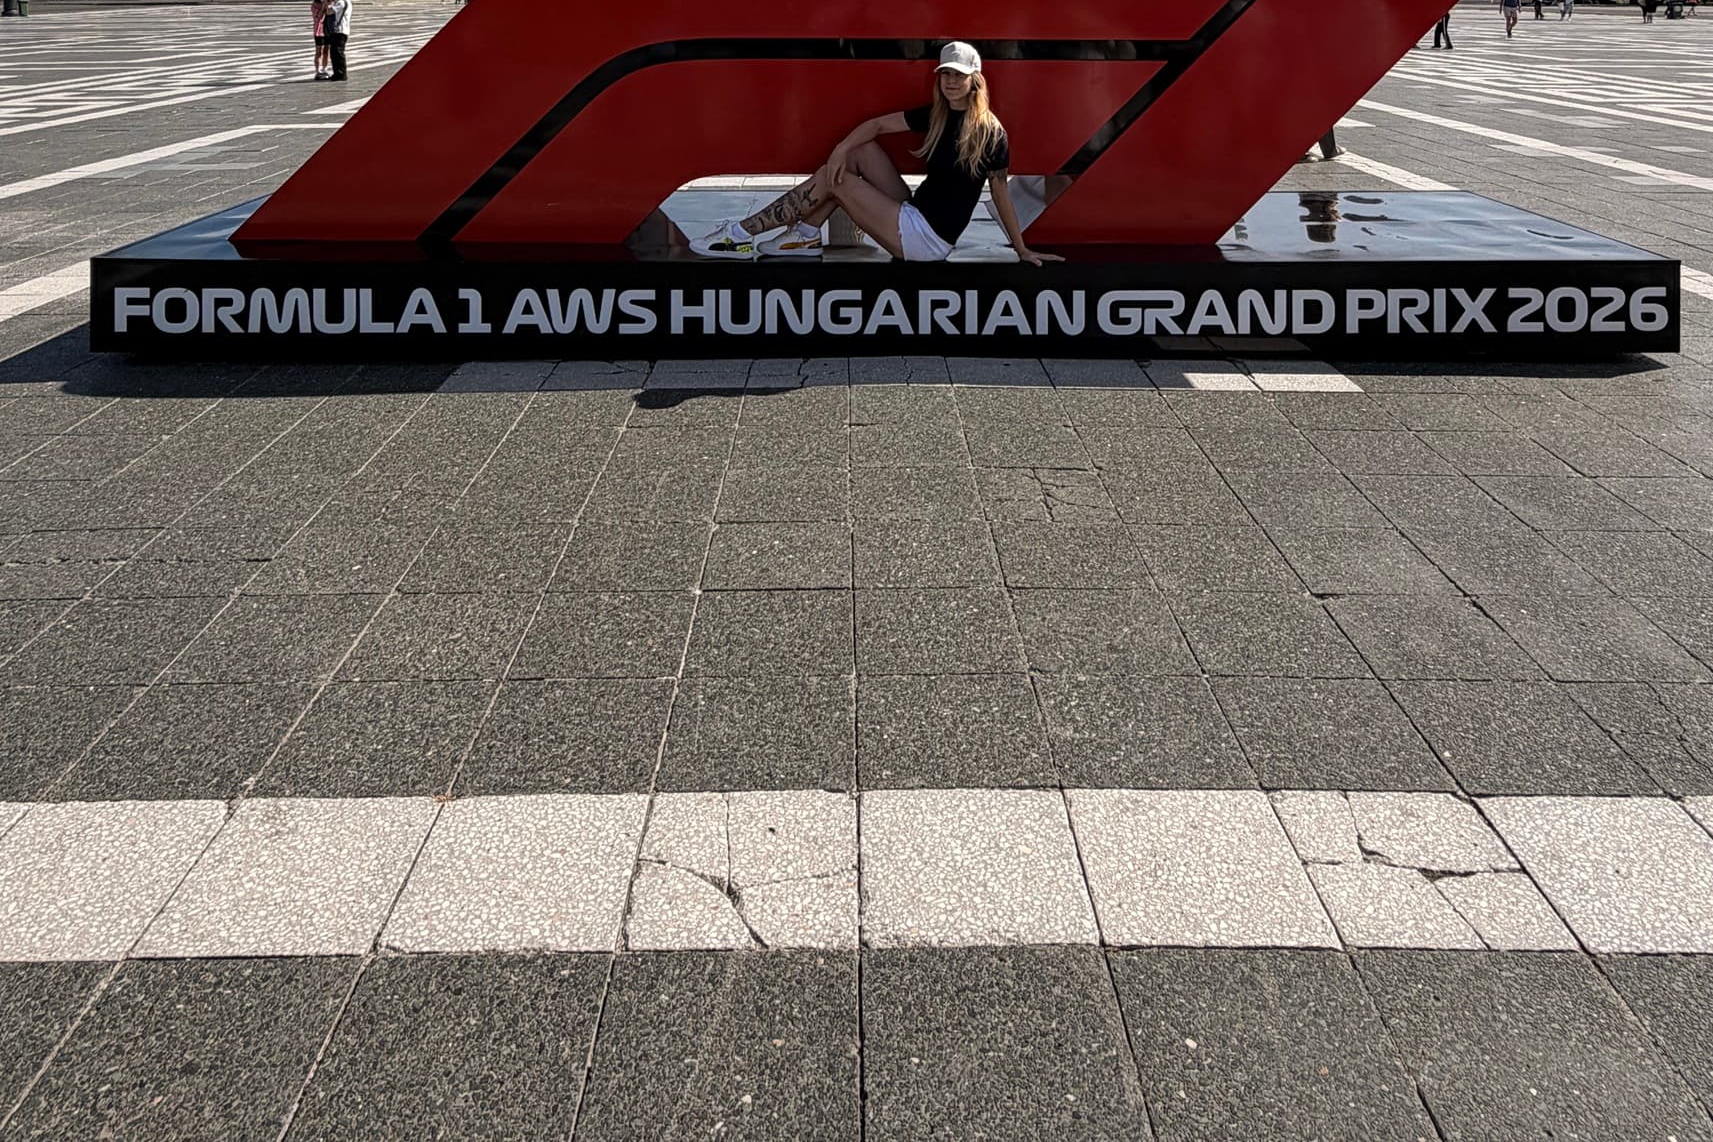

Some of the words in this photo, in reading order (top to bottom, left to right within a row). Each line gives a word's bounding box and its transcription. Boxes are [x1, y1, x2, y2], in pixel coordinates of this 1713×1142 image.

[114, 287, 447, 334] FORMULA
[458, 288, 492, 334] 1
[502, 288, 658, 334] AWS
[670, 289, 1086, 336] HUNGARIAN
[1096, 289, 1336, 336] GRAND
[1346, 288, 1498, 334] PRIX
[1507, 286, 1669, 333] 2026
